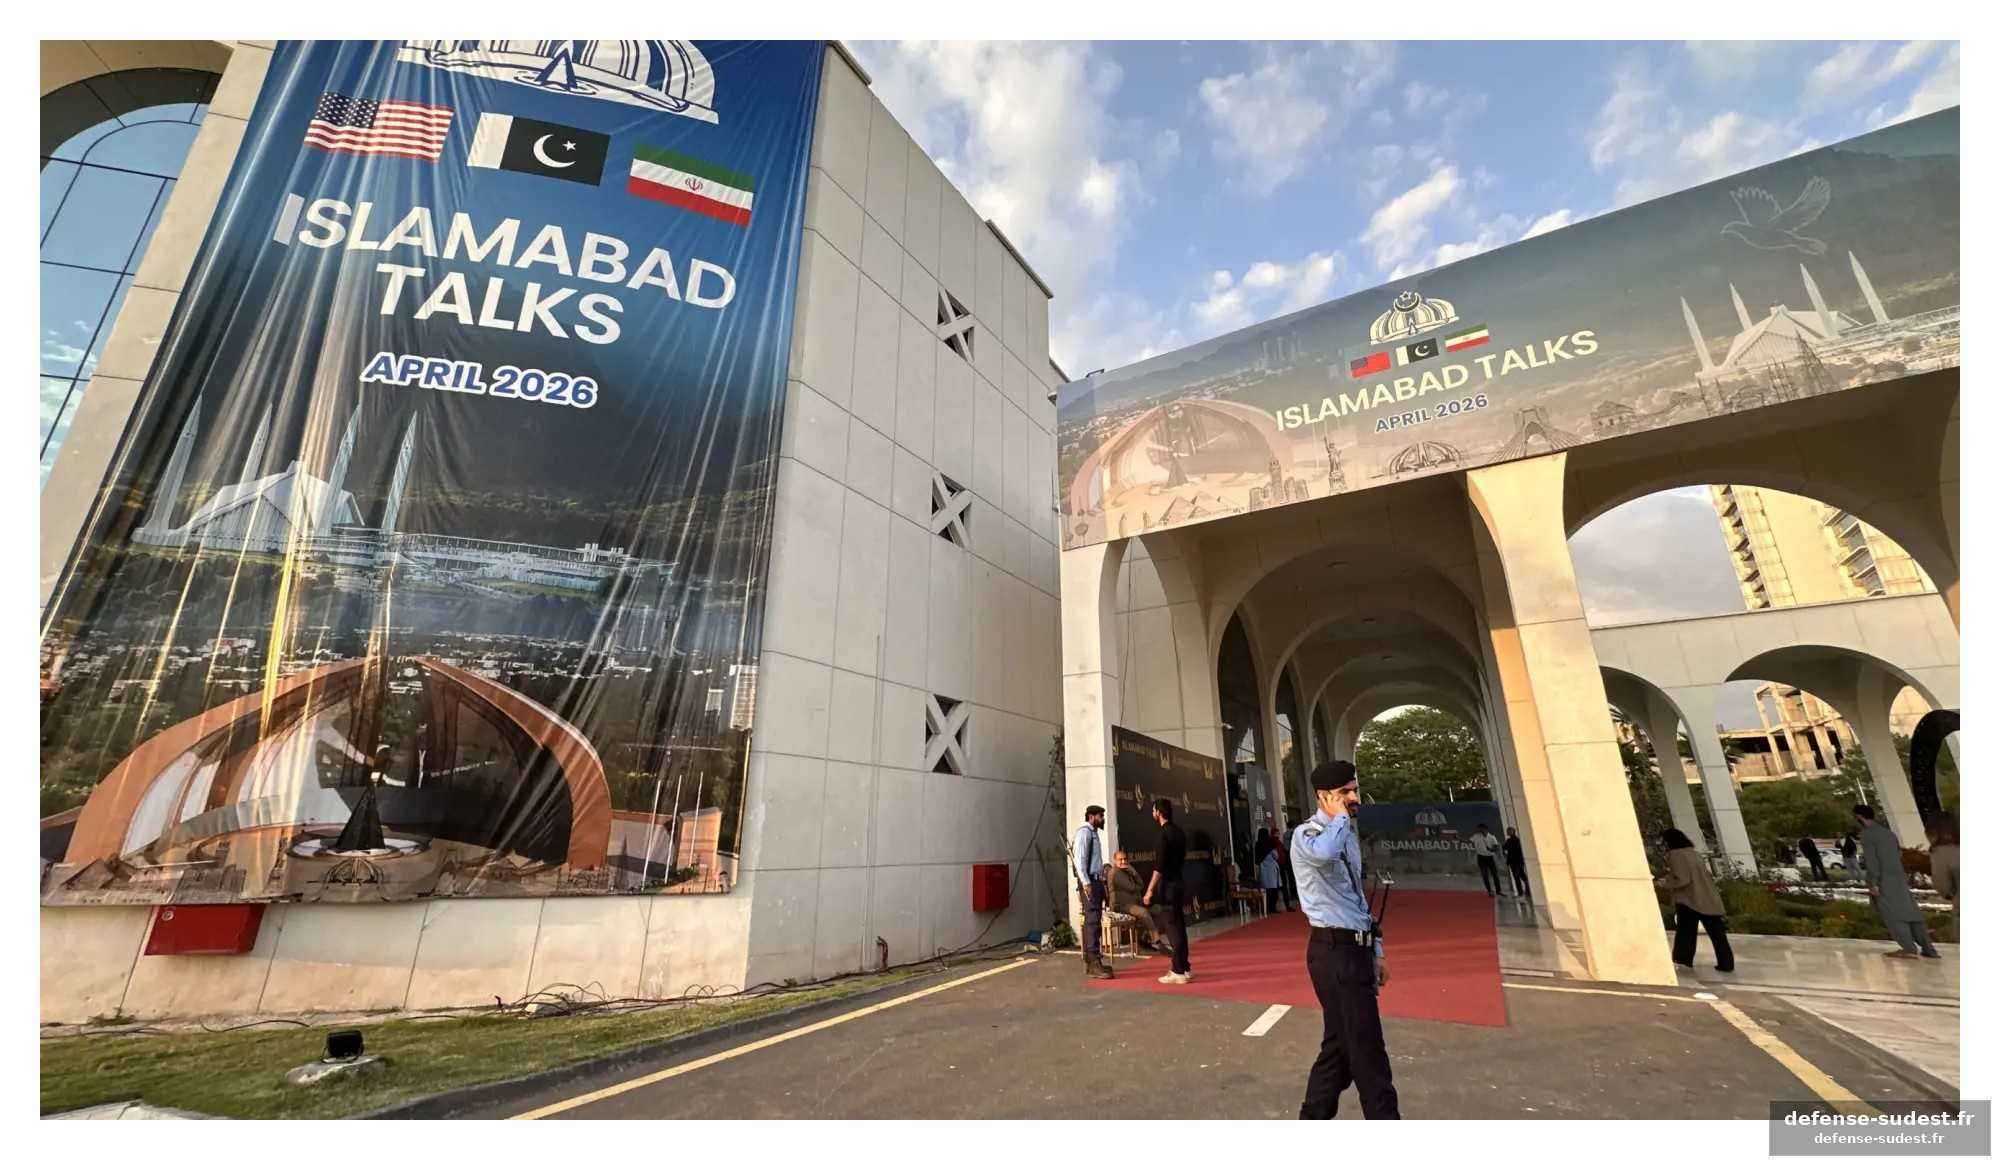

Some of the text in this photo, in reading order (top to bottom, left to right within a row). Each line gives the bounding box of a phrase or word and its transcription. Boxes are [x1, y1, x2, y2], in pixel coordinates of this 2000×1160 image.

[273, 192, 736, 311] ISLAMABAD
[374, 261, 625, 346] TALKS
[360, 352, 600, 408] APRIL 2026
[1276, 330, 1599, 431] ISLAMABAD TALKS
[1375, 394, 1489, 433] APRIL 2026
[1380, 839, 1450, 851] ISLAMABAD
